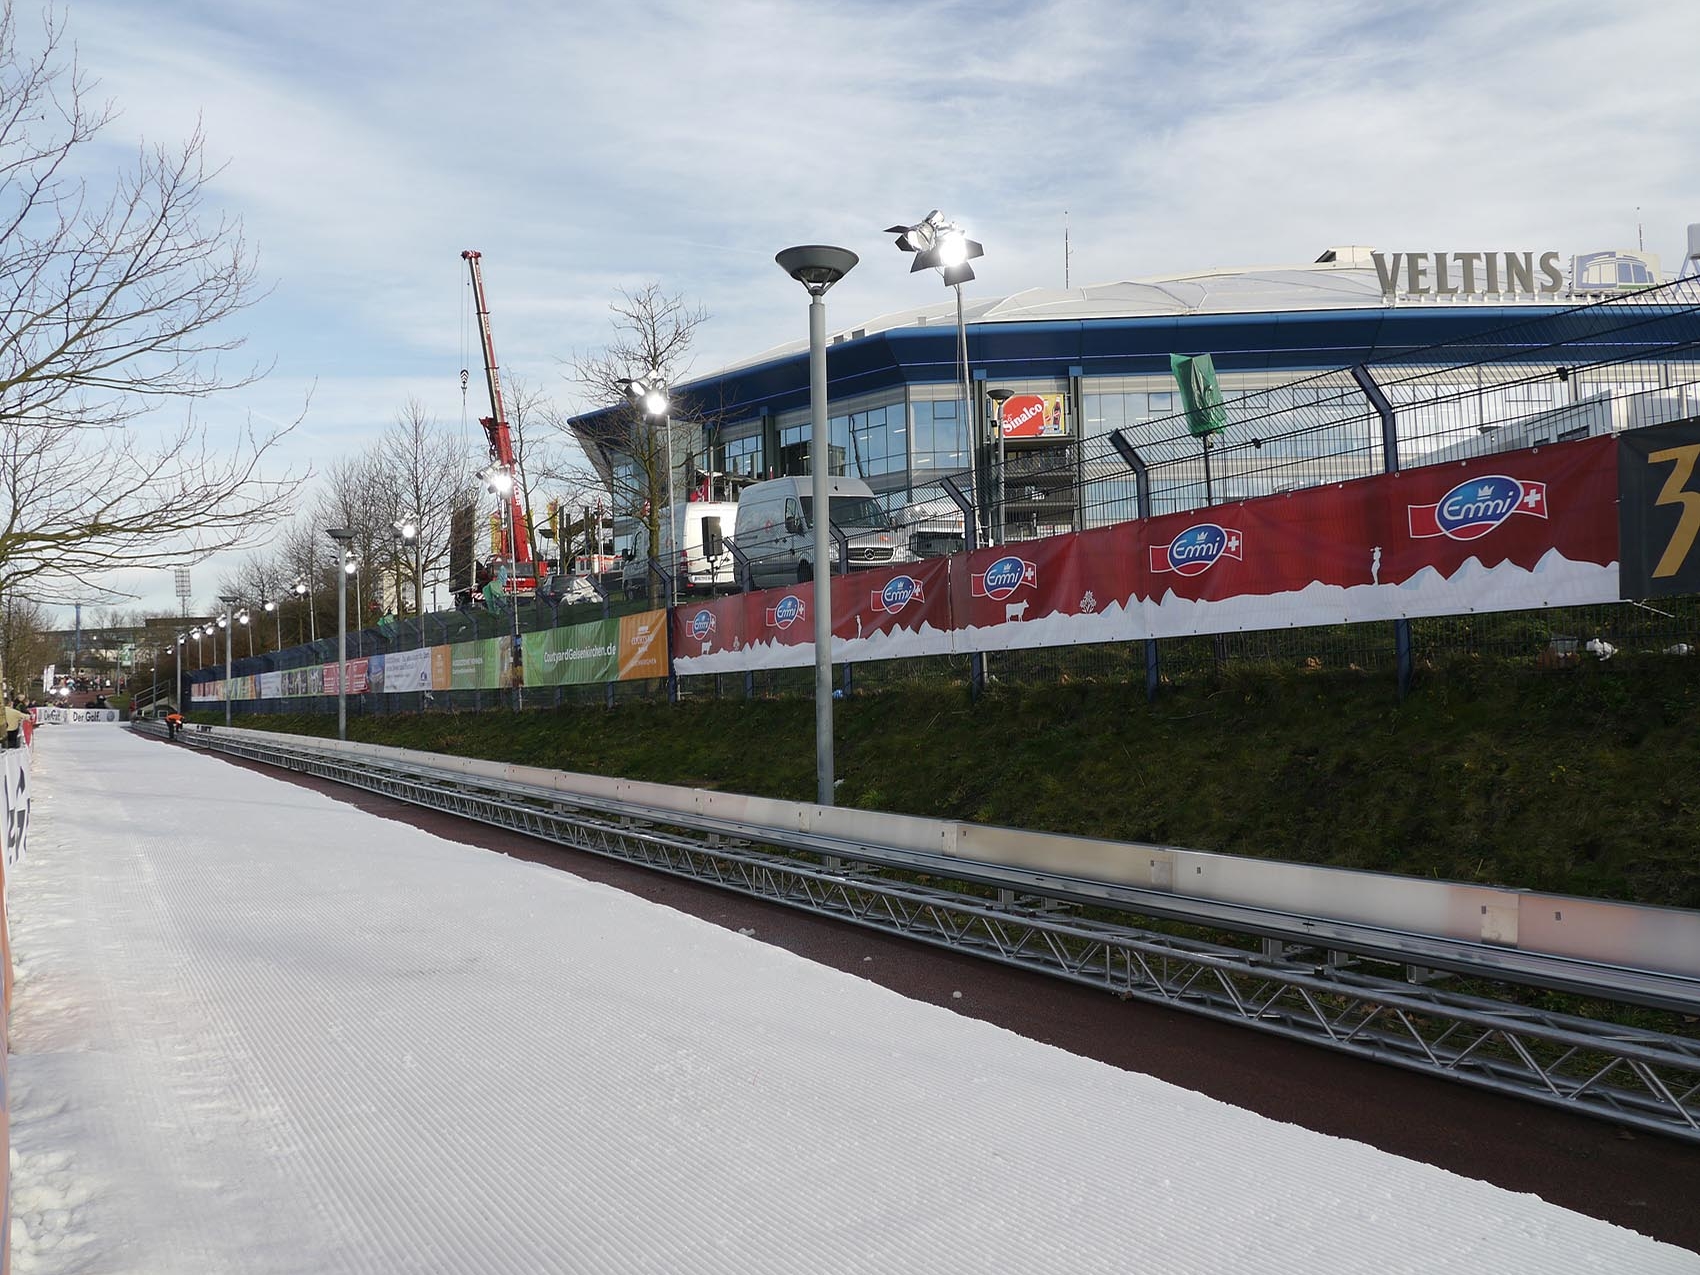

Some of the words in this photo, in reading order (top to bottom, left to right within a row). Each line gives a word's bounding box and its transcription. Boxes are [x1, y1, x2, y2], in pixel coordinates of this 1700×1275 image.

[1372, 251, 1564, 294] VELTINS
[1003, 404, 1043, 433] Sinalco
[1442, 490, 1514, 521] Emmi
[1173, 536, 1220, 560] Emmi
[987, 567, 1021, 586] Emmi
[884, 584, 913, 603] Emmi
[776, 602, 797, 620] Emmi
[693, 619, 711, 633] Emmi
[73, 711, 84, 722] Der
